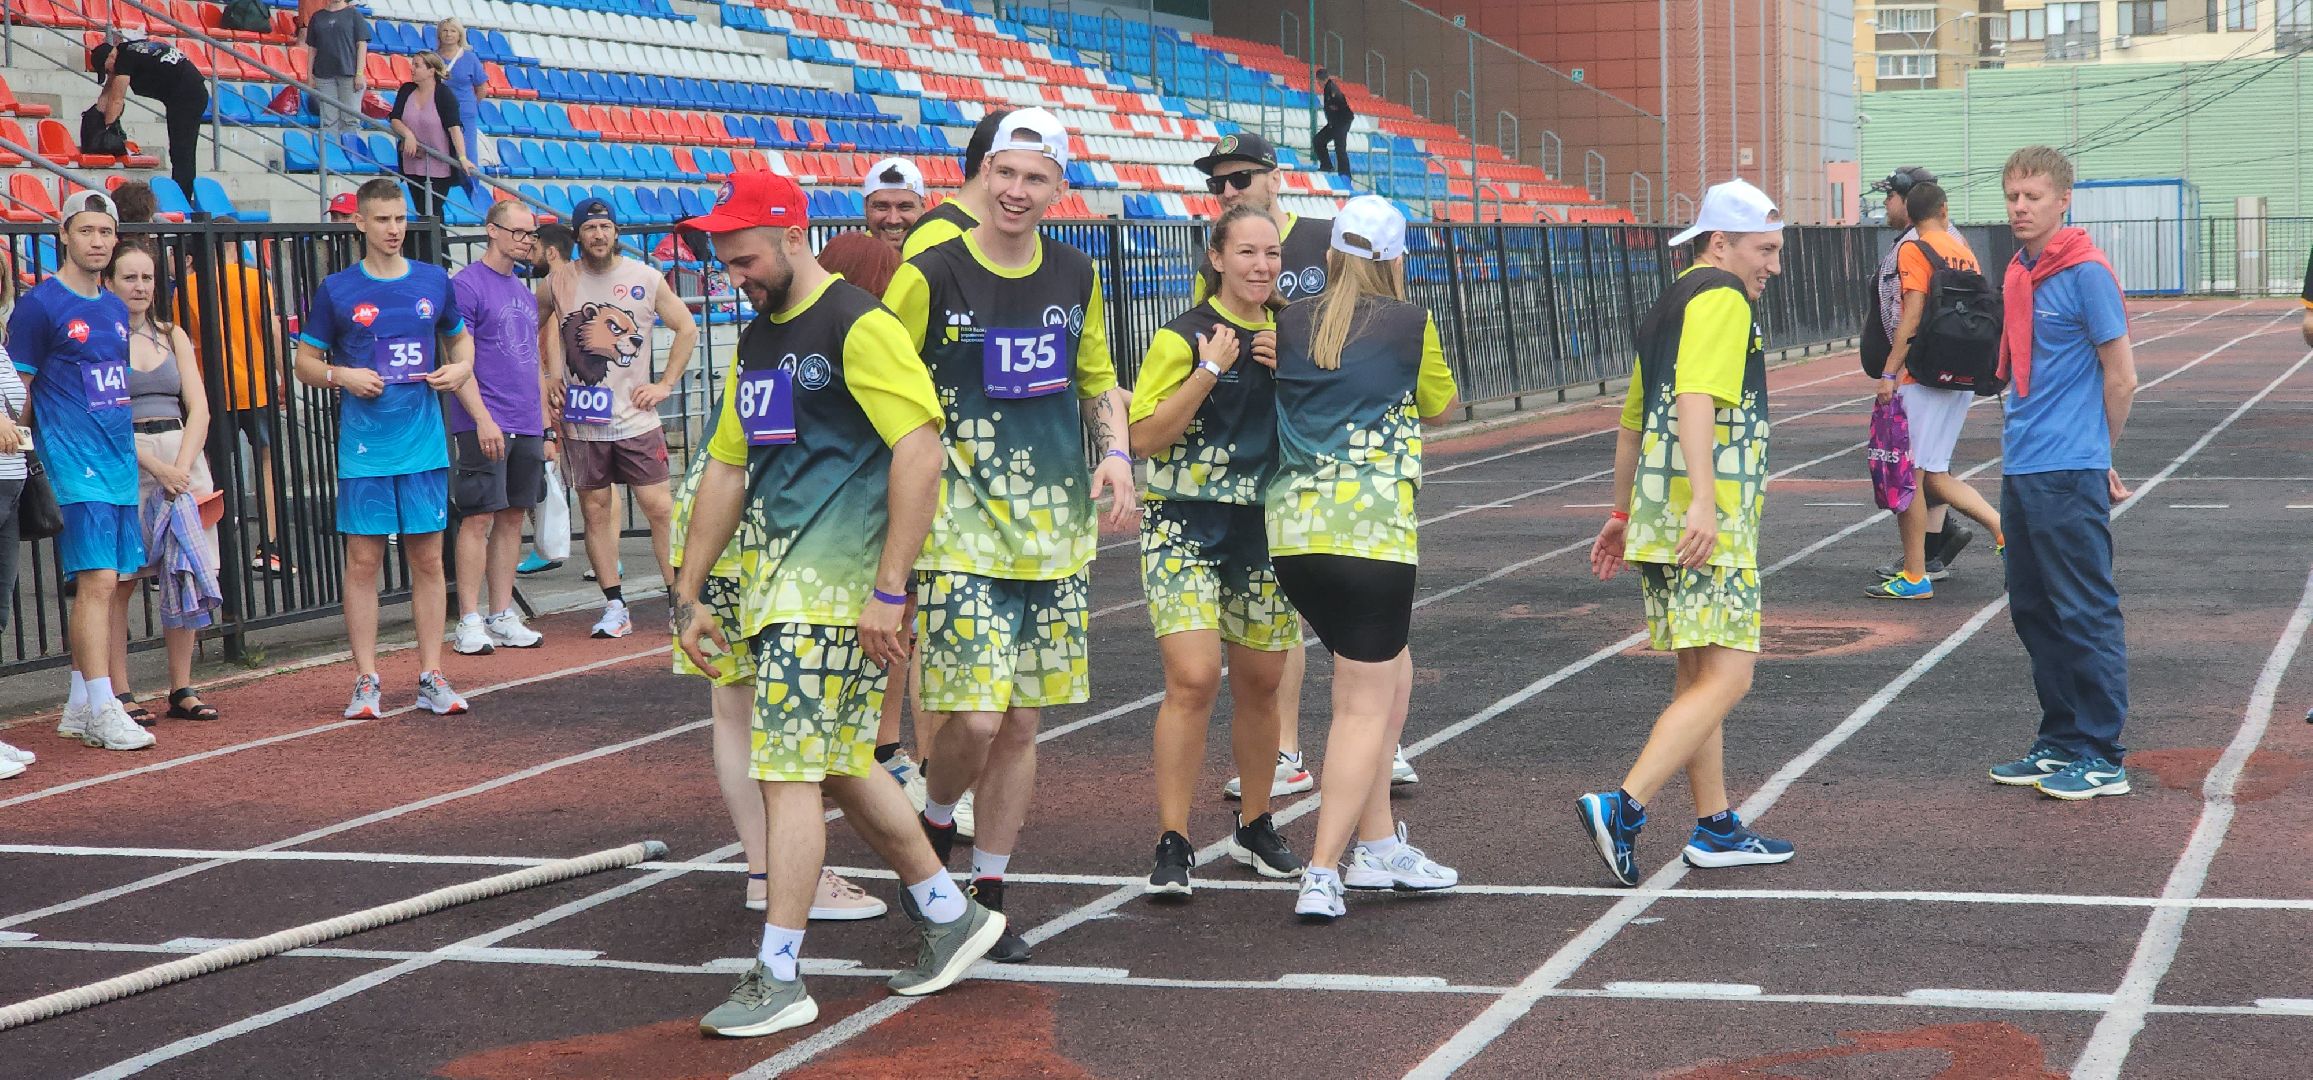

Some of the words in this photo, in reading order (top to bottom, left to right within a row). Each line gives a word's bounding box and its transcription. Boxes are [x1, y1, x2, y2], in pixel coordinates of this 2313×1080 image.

[388, 341, 423, 367] 35
[995, 333, 1056, 373] 135
[90, 365, 126, 392] 141
[569, 388, 608, 412] 100
[740, 378, 774, 419] 87
